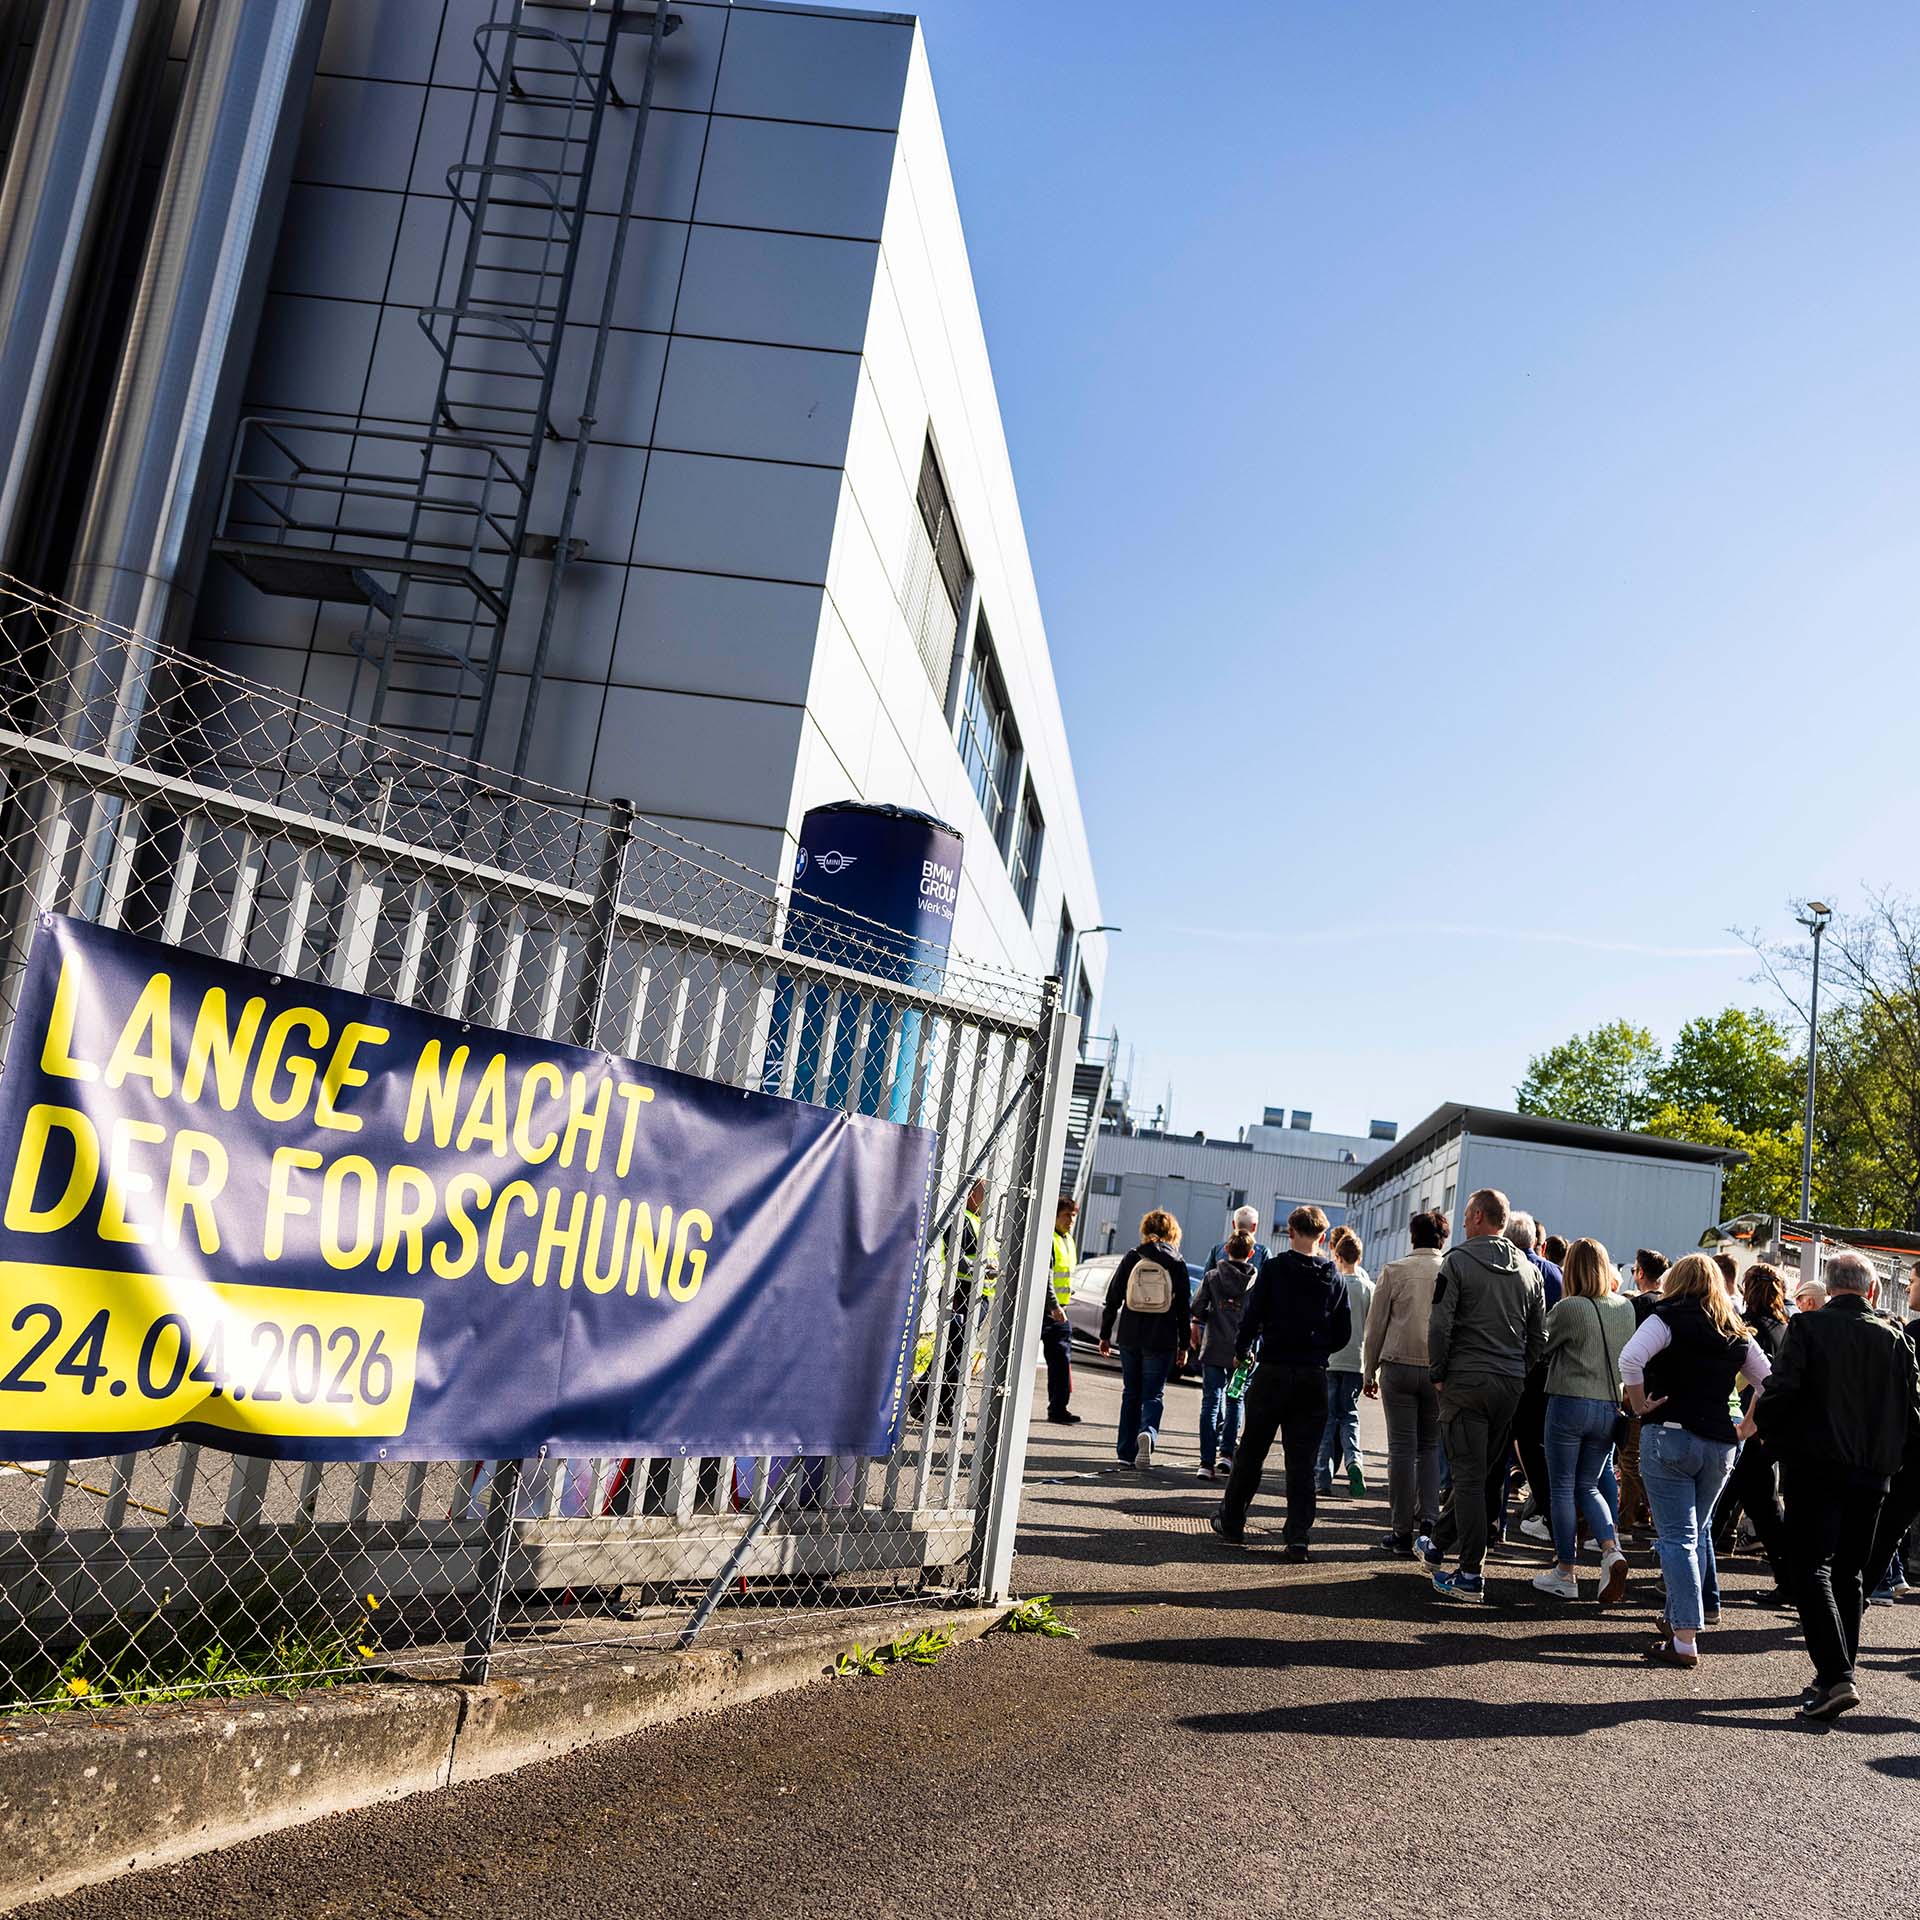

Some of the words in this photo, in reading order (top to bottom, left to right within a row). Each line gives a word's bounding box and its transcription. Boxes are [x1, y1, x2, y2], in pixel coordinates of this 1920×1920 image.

[920, 877, 957, 904] GROUP
[922, 860, 954, 885] BMW
[918, 897, 941, 915] Werk
[40, 951, 390, 1133] LANGE
[403, 1039, 655, 1178] NACHT
[4, 1104, 229, 1256] DER
[263, 1147, 713, 1303] FORSCHUNG
[0, 1303, 393, 1406] 24.04.2026
